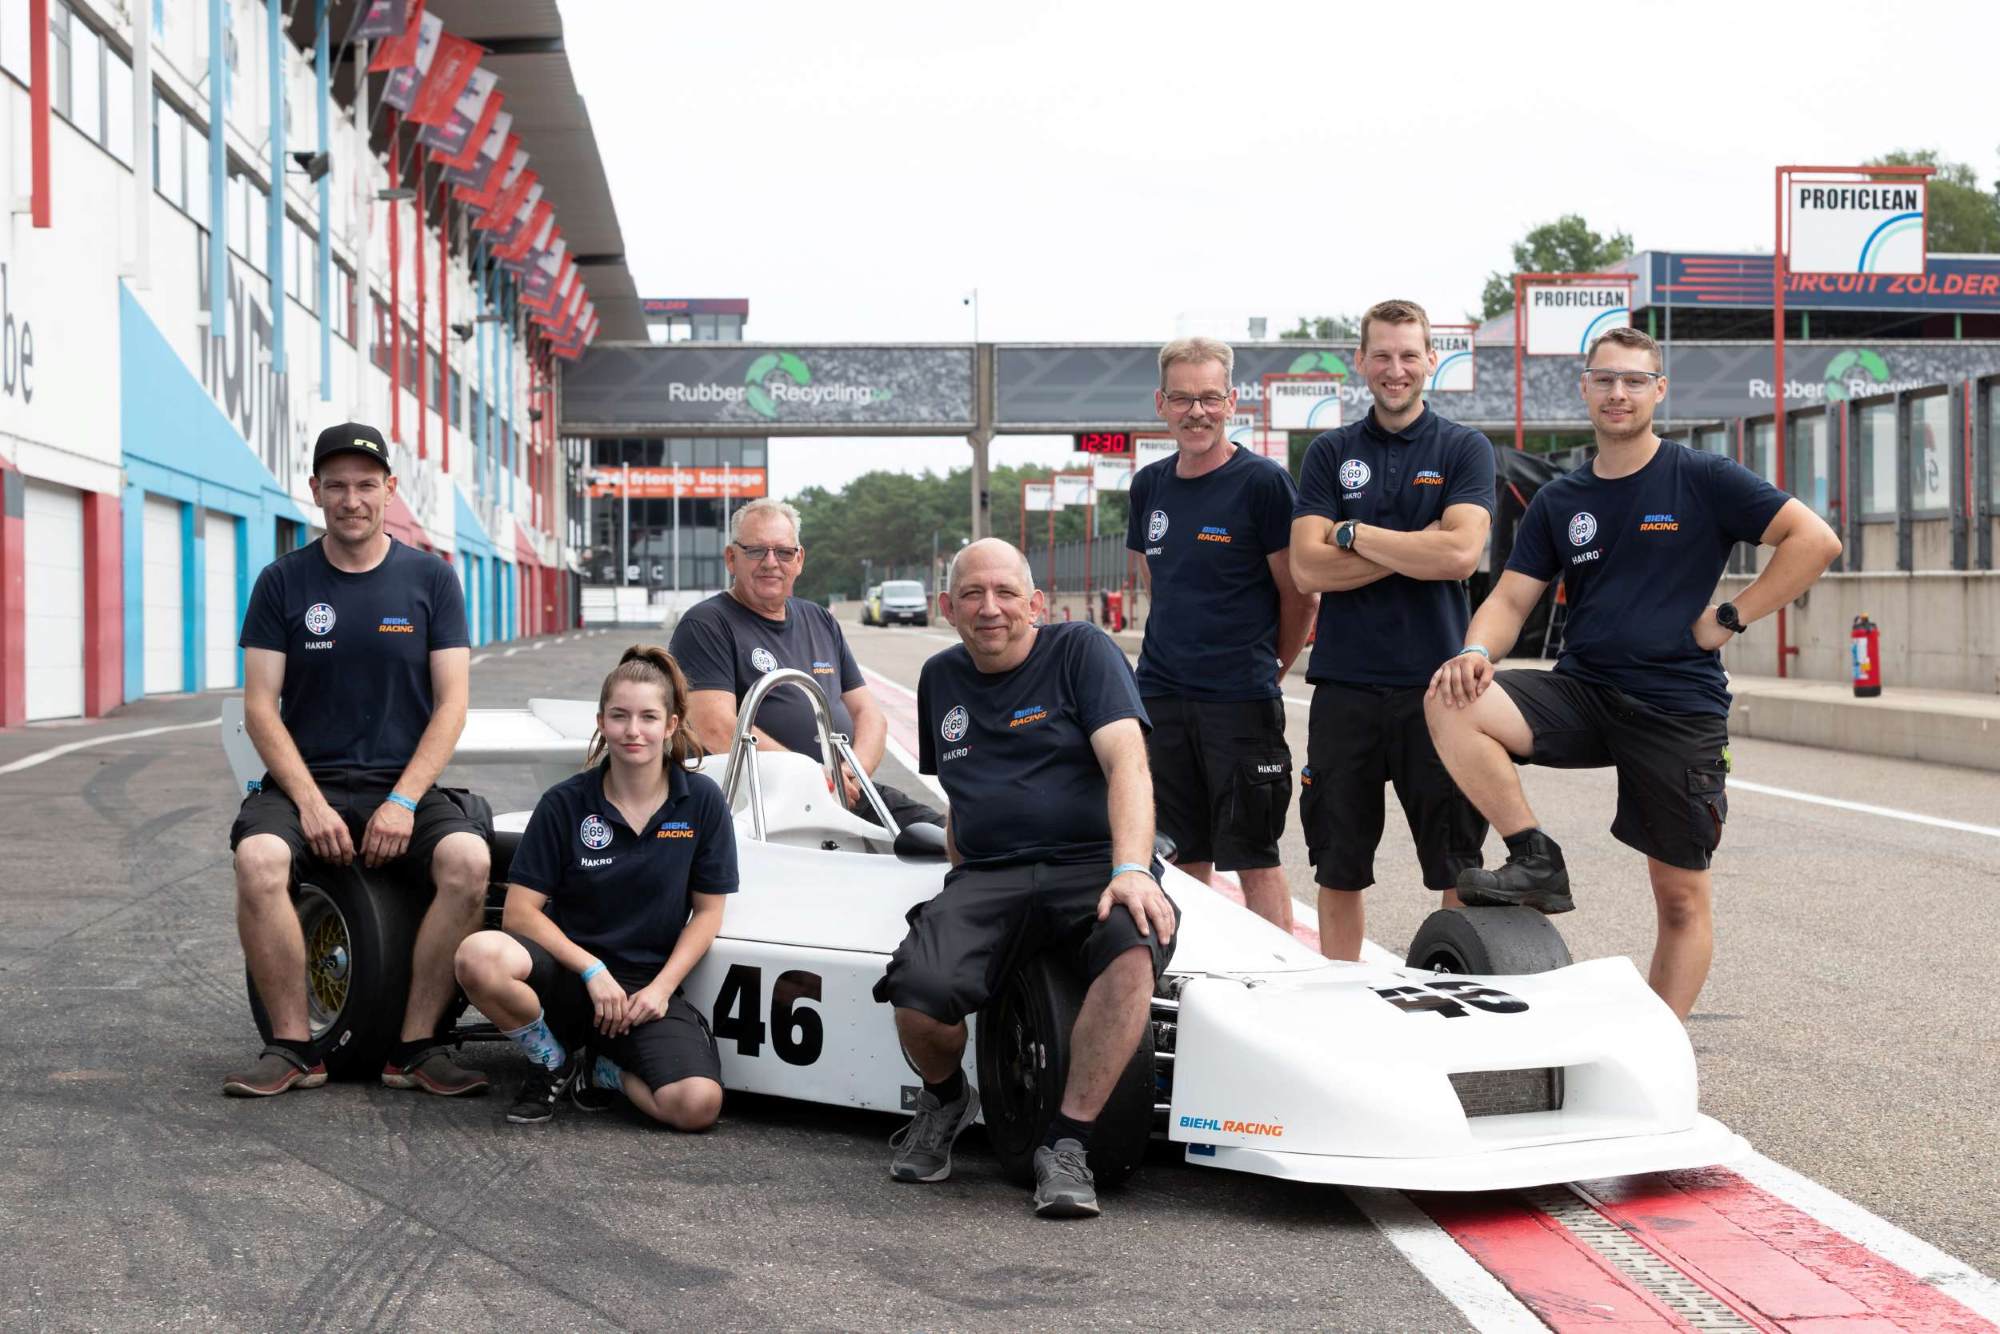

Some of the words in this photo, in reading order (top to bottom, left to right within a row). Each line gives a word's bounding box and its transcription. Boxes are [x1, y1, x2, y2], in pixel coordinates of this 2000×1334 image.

[1800, 188, 1917, 210] PROFICLEAN
[1887, 273, 1999, 295] ZOLDER
[1534, 290, 1624, 307] PROFICLEAN
[1432, 337, 1469, 352] CLEAN
[668, 382, 745, 402] Rubber
[1275, 385, 1338, 397] PROFICLEAN
[1347, 469, 1361, 479] 69
[1644, 514, 1675, 522] BIEHL
[1151, 521, 1162, 530] 69
[1201, 526, 1228, 535] BIEHL
[1575, 523, 1588, 535] 69
[1640, 522, 1680, 531] RACING
[1197, 533, 1232, 543] RACING
[1571, 549, 1600, 566] HAKRO
[314, 614, 328, 624] 69
[382, 617, 410, 625] BIEHL
[378, 625, 415, 633] RACING
[305, 641, 333, 650] HAKRO
[1013, 705, 1044, 719] BIEHL
[950, 719, 962, 730] 69
[1009, 711, 1048, 729] RACING
[942, 747, 968, 762] HAKRO
[1257, 764, 1282, 773] HAKRO
[660, 821, 690, 830] BIEHL
[589, 826, 605, 838] 69
[657, 830, 695, 839] RACING
[580, 857, 613, 867] HAKRO
[1367, 981, 1530, 1018] 46
[713, 963, 824, 1066] 46
